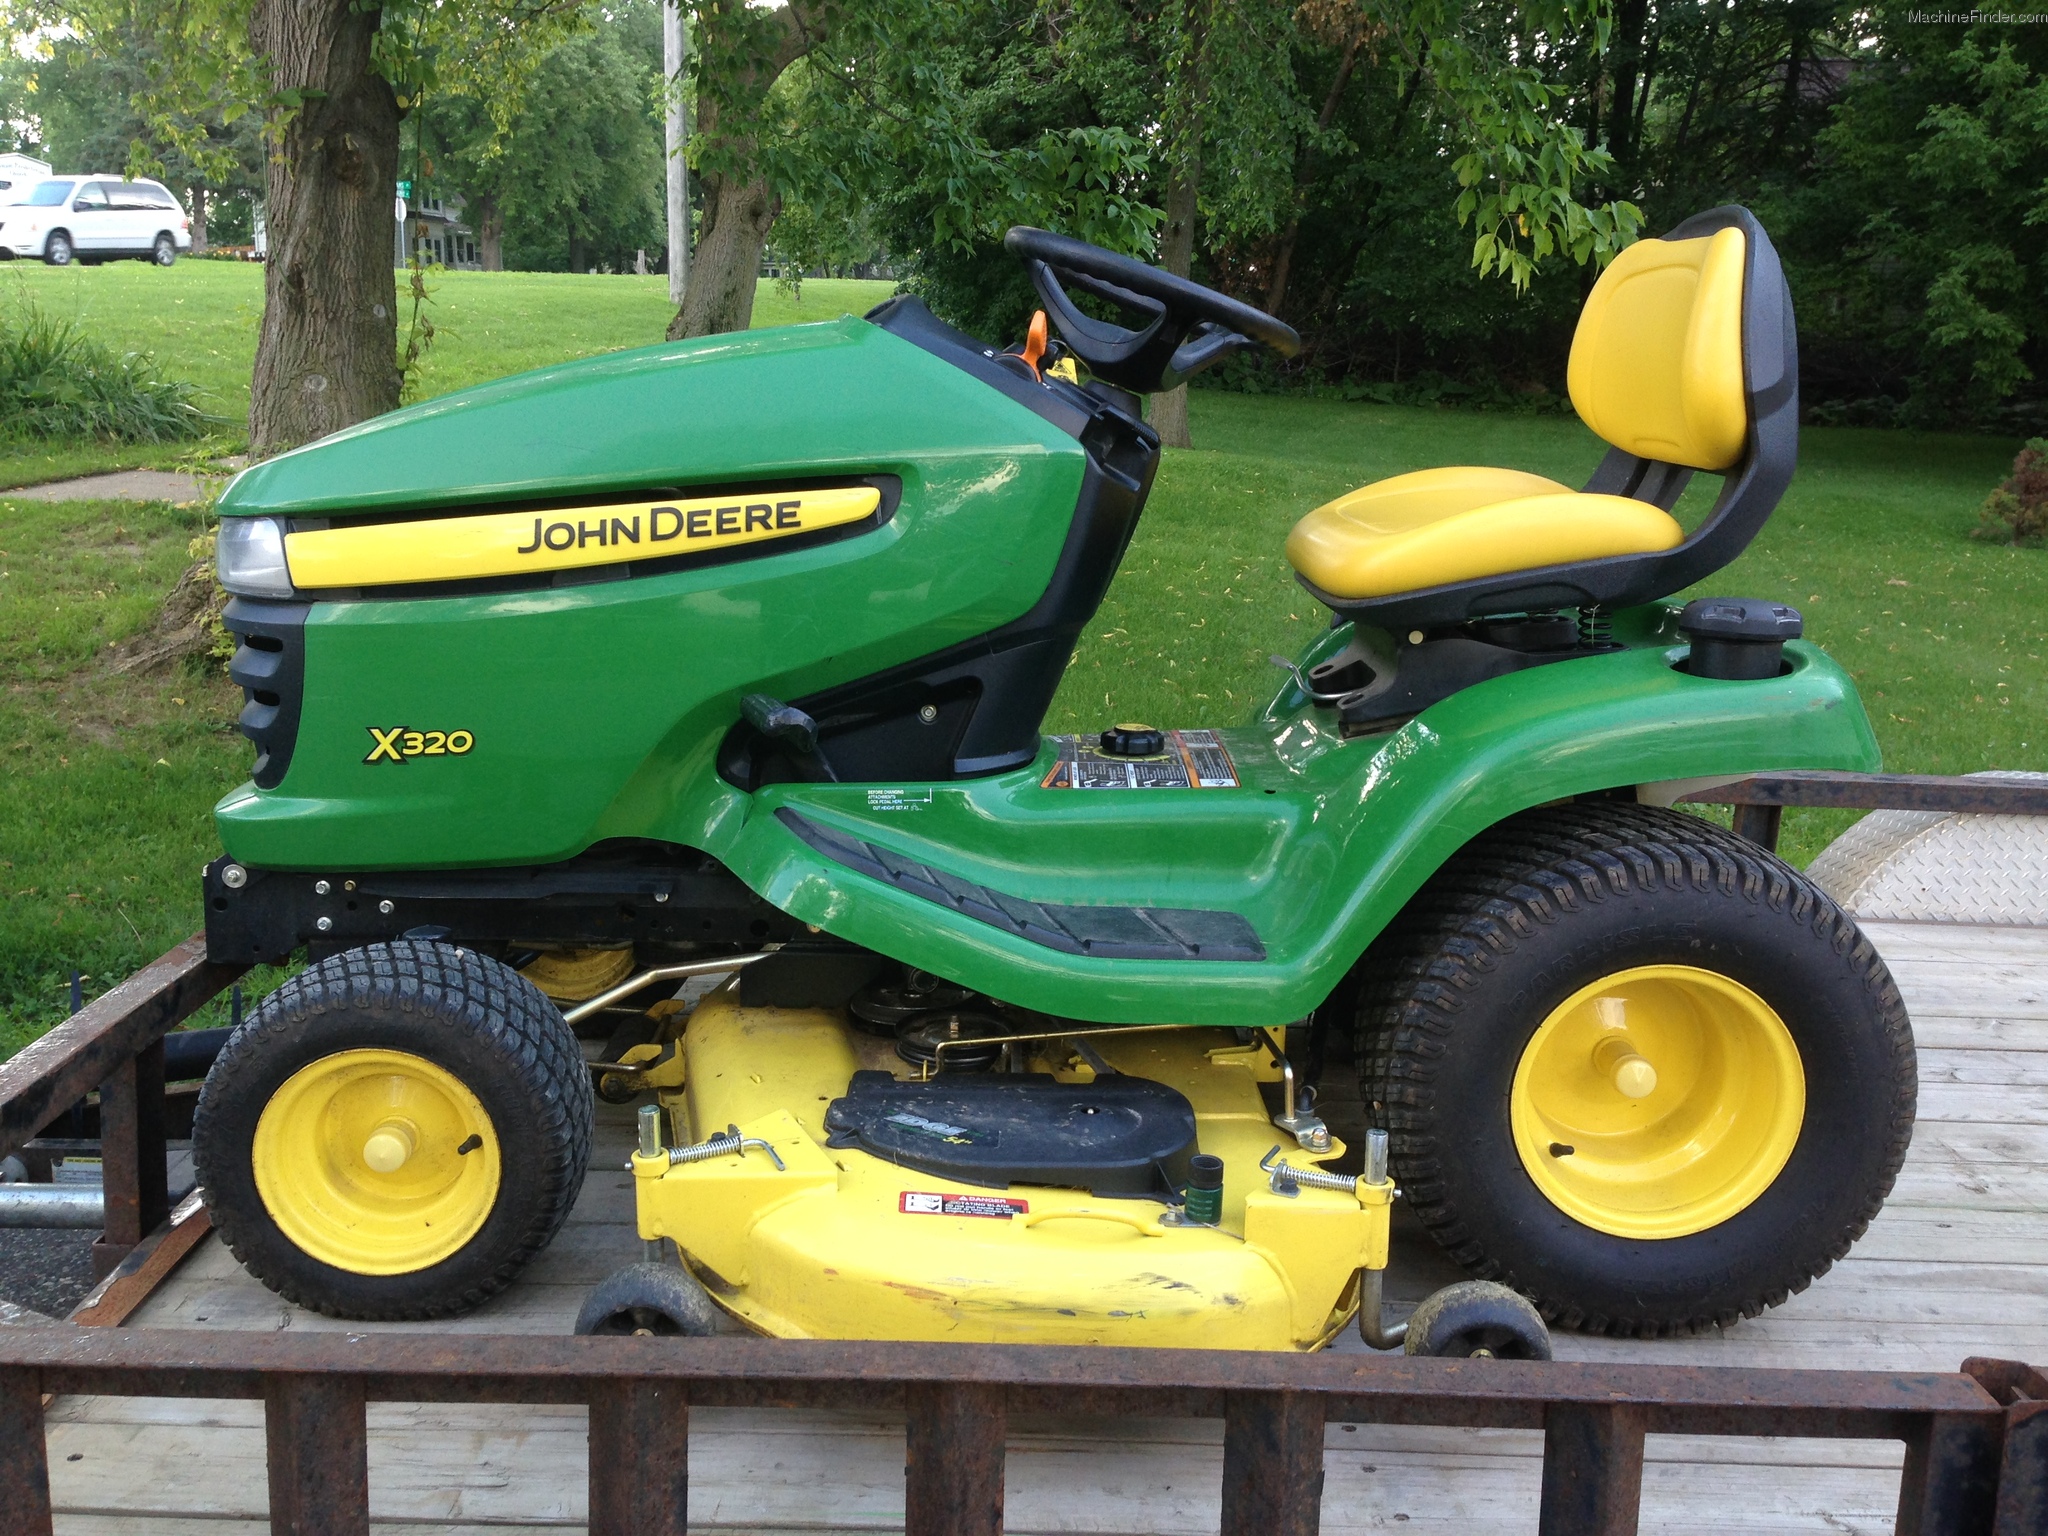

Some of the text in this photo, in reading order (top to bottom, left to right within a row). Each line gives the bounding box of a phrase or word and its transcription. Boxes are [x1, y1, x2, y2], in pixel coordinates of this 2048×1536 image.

[517, 500, 802, 554] JOHN DEERE
[364, 727, 474, 763] X320
[968, 1196, 1007, 1204] DANGER
